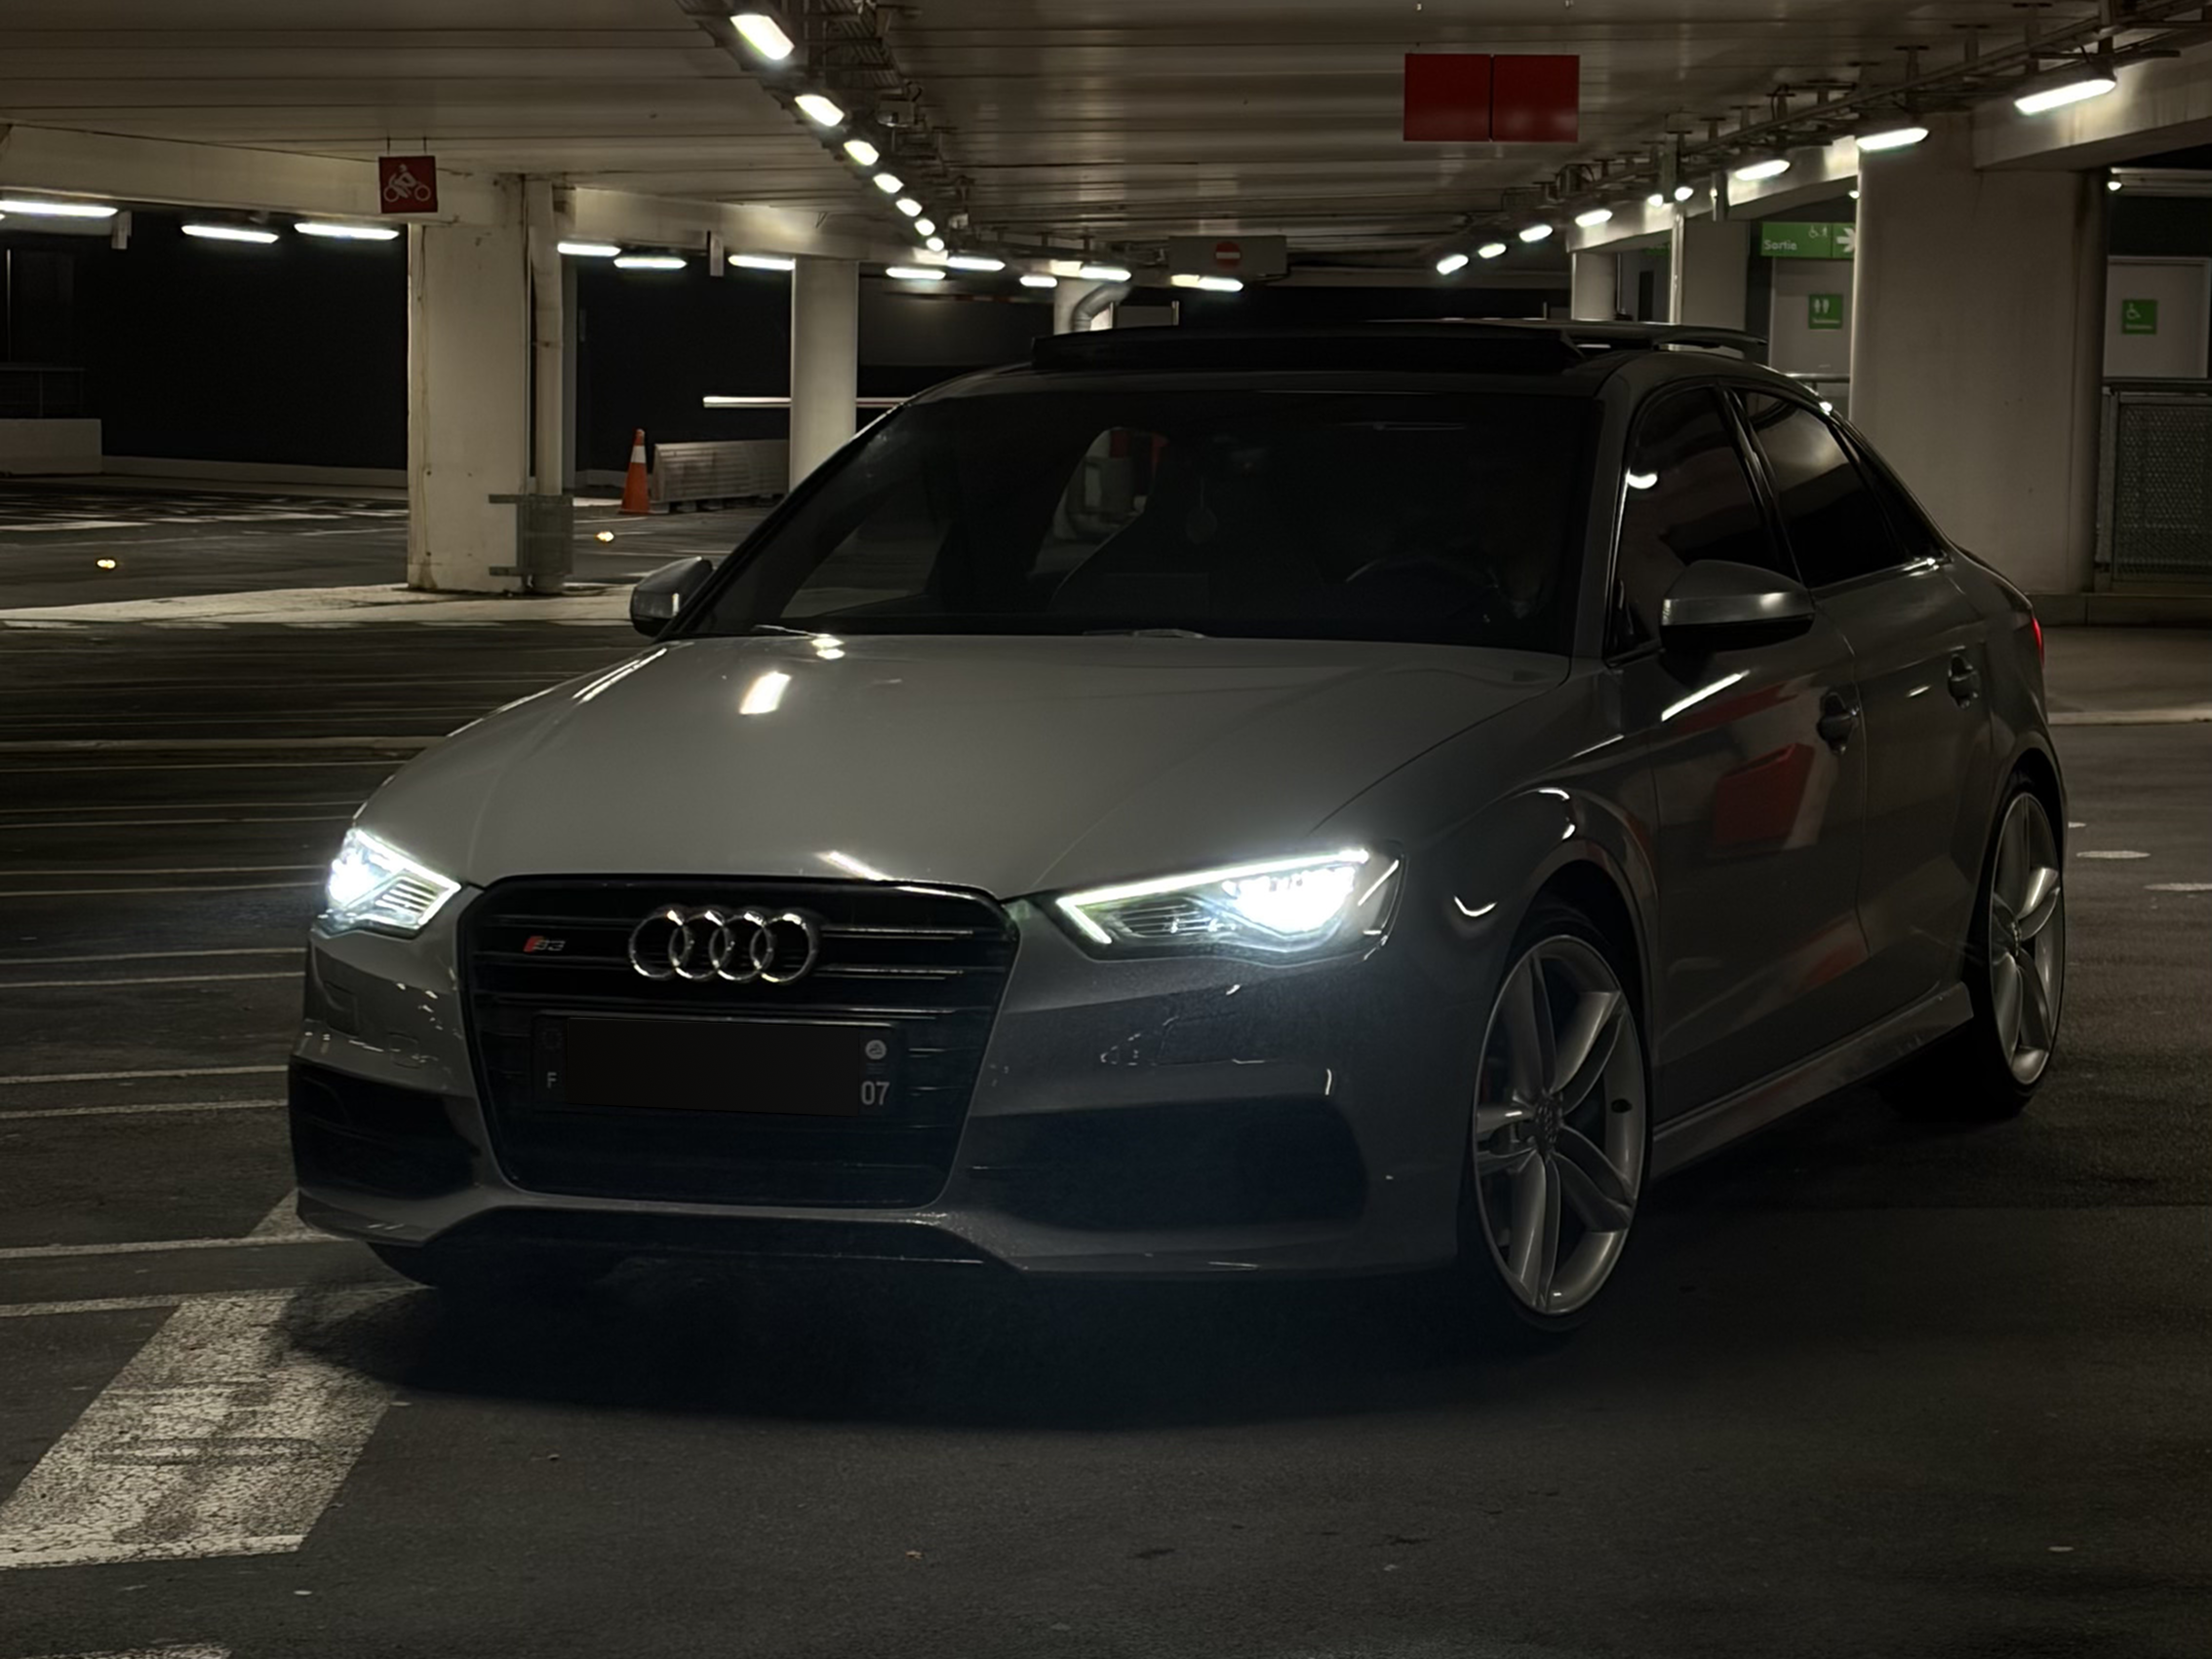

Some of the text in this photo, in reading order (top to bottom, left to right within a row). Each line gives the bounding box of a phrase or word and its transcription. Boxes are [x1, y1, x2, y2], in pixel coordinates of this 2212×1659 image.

[1763, 239, 1797, 251] Sortie
[546, 1071, 558, 1089] F
[860, 1080, 891, 1106] 07
